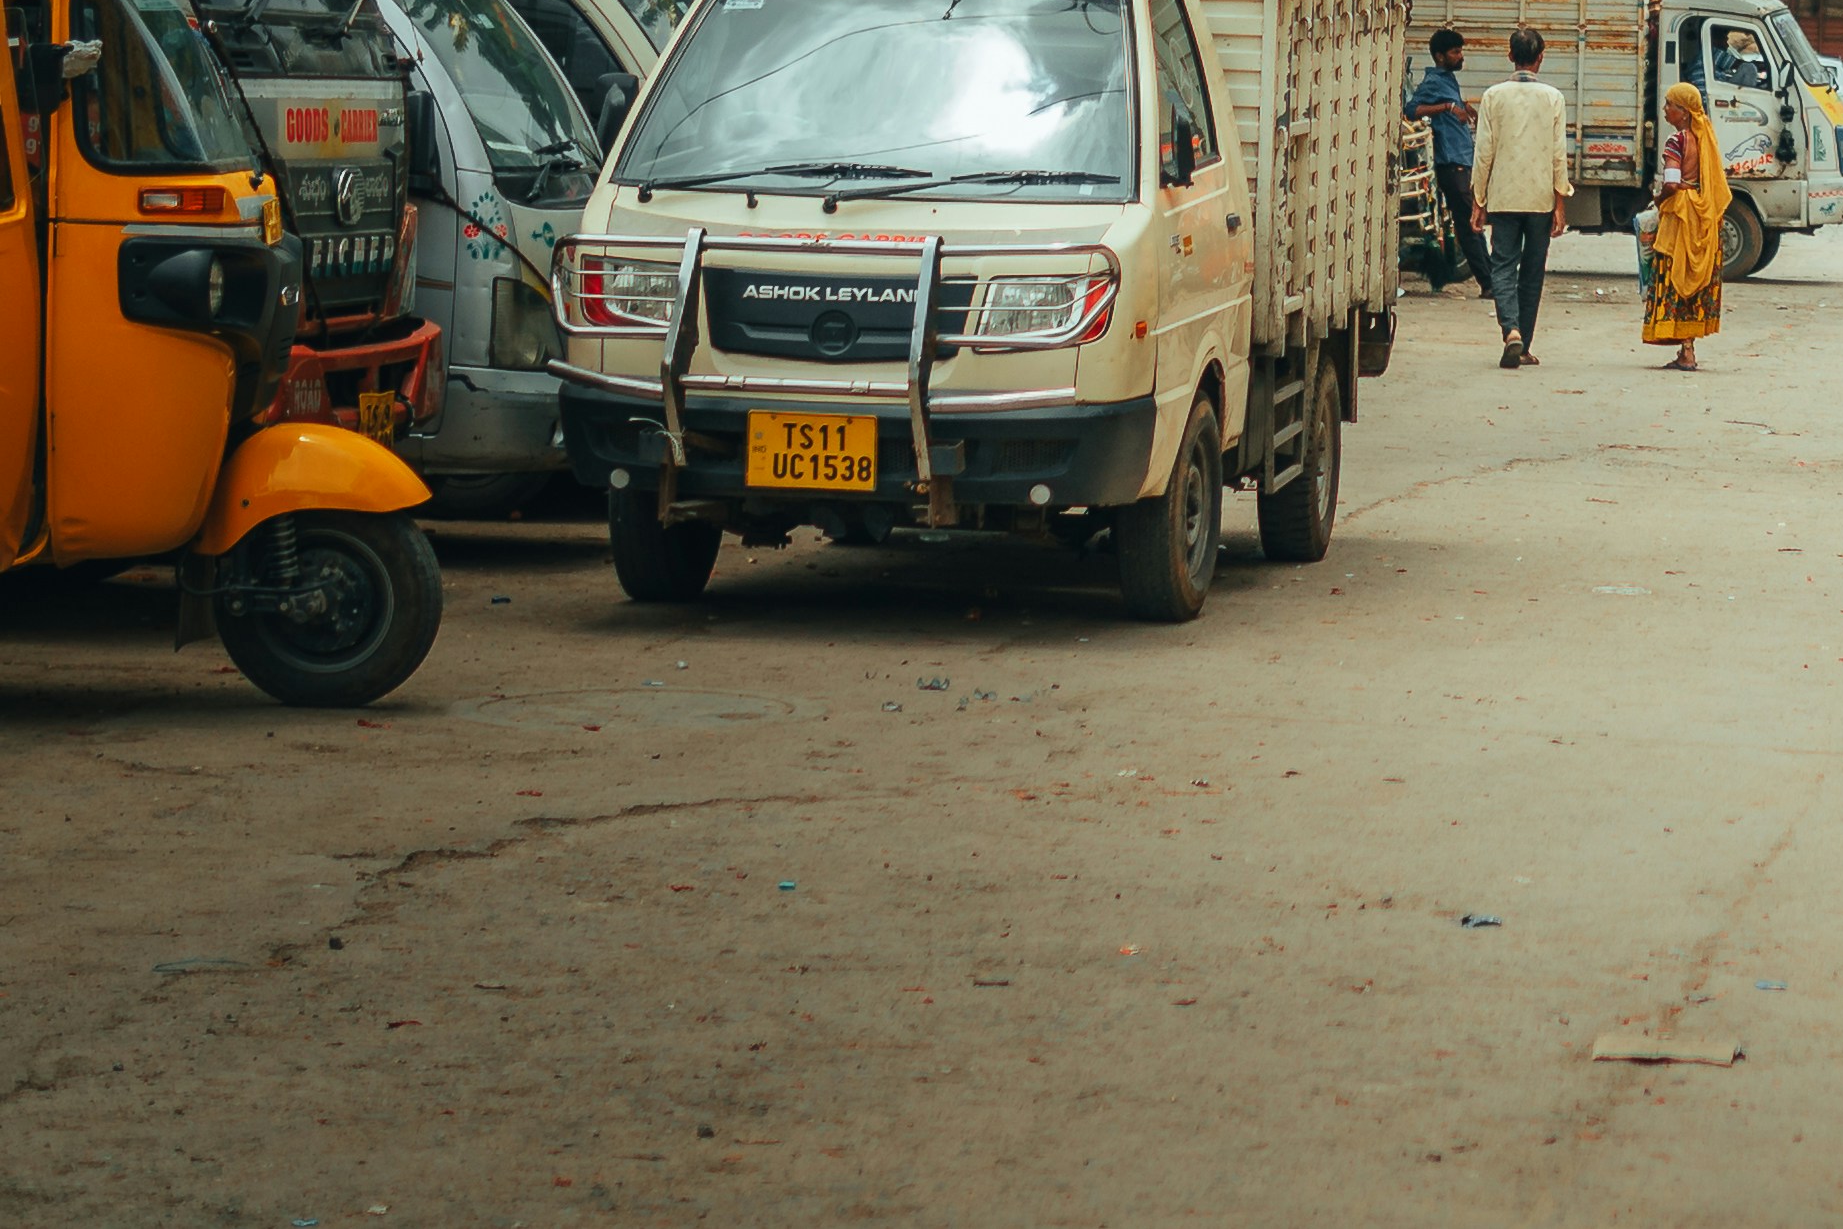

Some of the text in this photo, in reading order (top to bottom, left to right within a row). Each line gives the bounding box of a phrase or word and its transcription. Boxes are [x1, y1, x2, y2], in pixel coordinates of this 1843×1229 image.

[286, 108, 329, 143] GOODS
[341, 109, 378, 143] CARRIER
[311, 235, 395, 277] EICHER
[742, 285, 821, 301] ASHOK
[783, 423, 846, 451] TS11
[773, 453, 872, 482] UC1538
